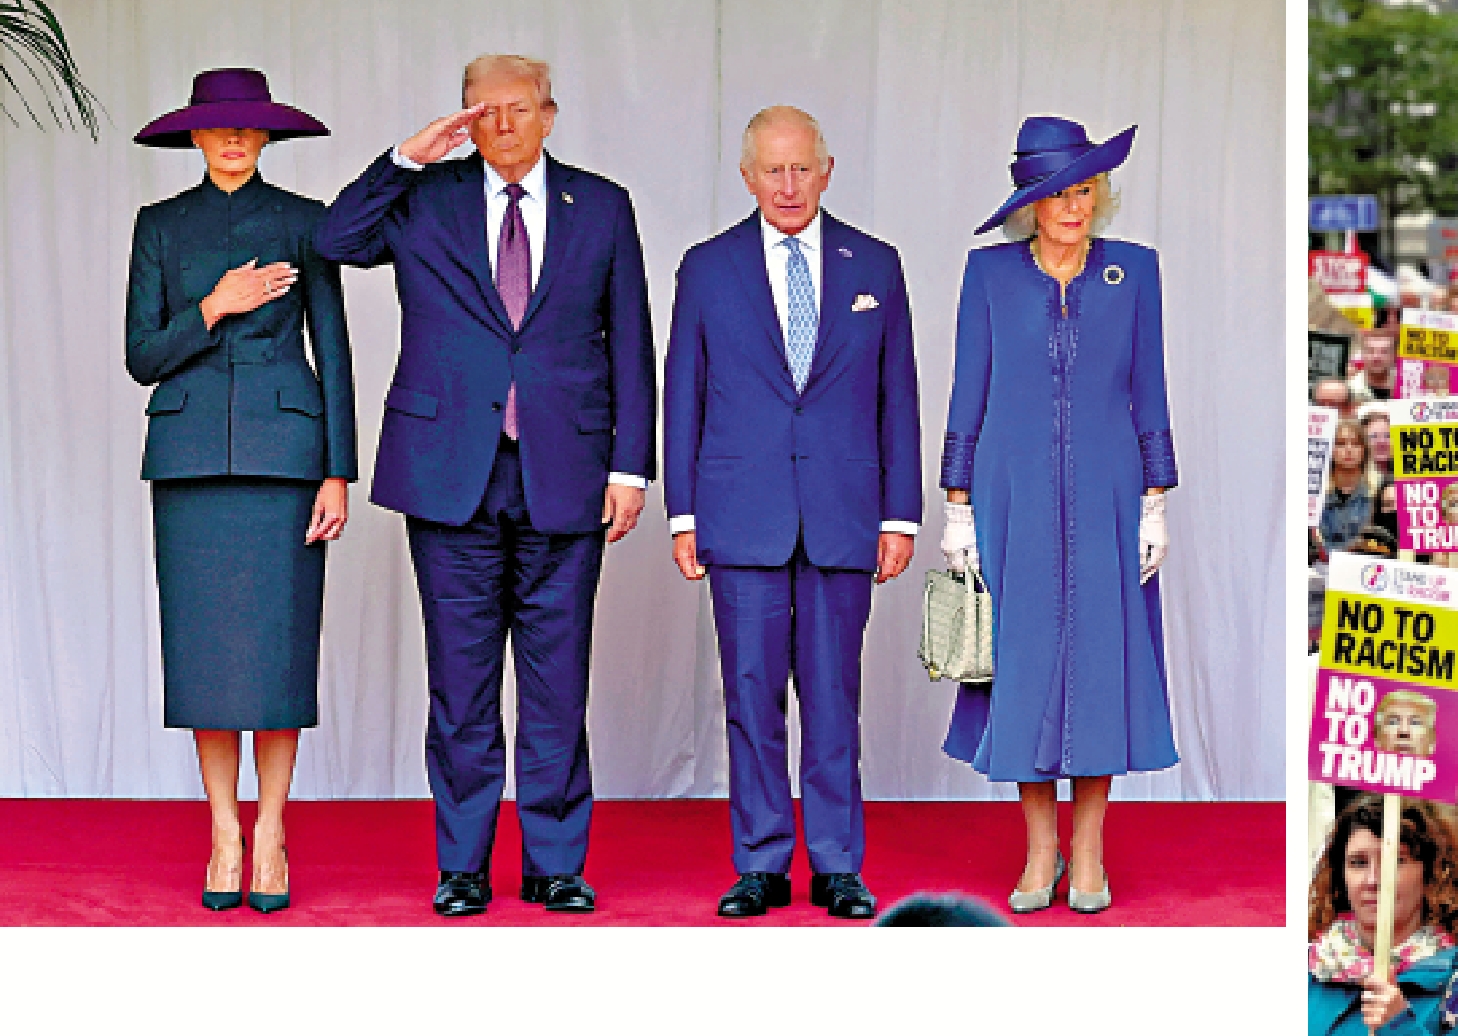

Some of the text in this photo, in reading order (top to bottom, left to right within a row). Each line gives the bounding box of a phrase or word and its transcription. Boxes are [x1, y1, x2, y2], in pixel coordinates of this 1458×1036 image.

[1400, 428, 1435, 453] NO
[1403, 480, 1439, 504] NO
[1406, 504, 1439, 528] TO
[1337, 598, 1435, 644] NO TO
[1333, 631, 1456, 682] RACISM
[1327, 675, 1376, 717] NO
[1323, 710, 1371, 747] TO
[1318, 741, 1437, 792] TRUMP
